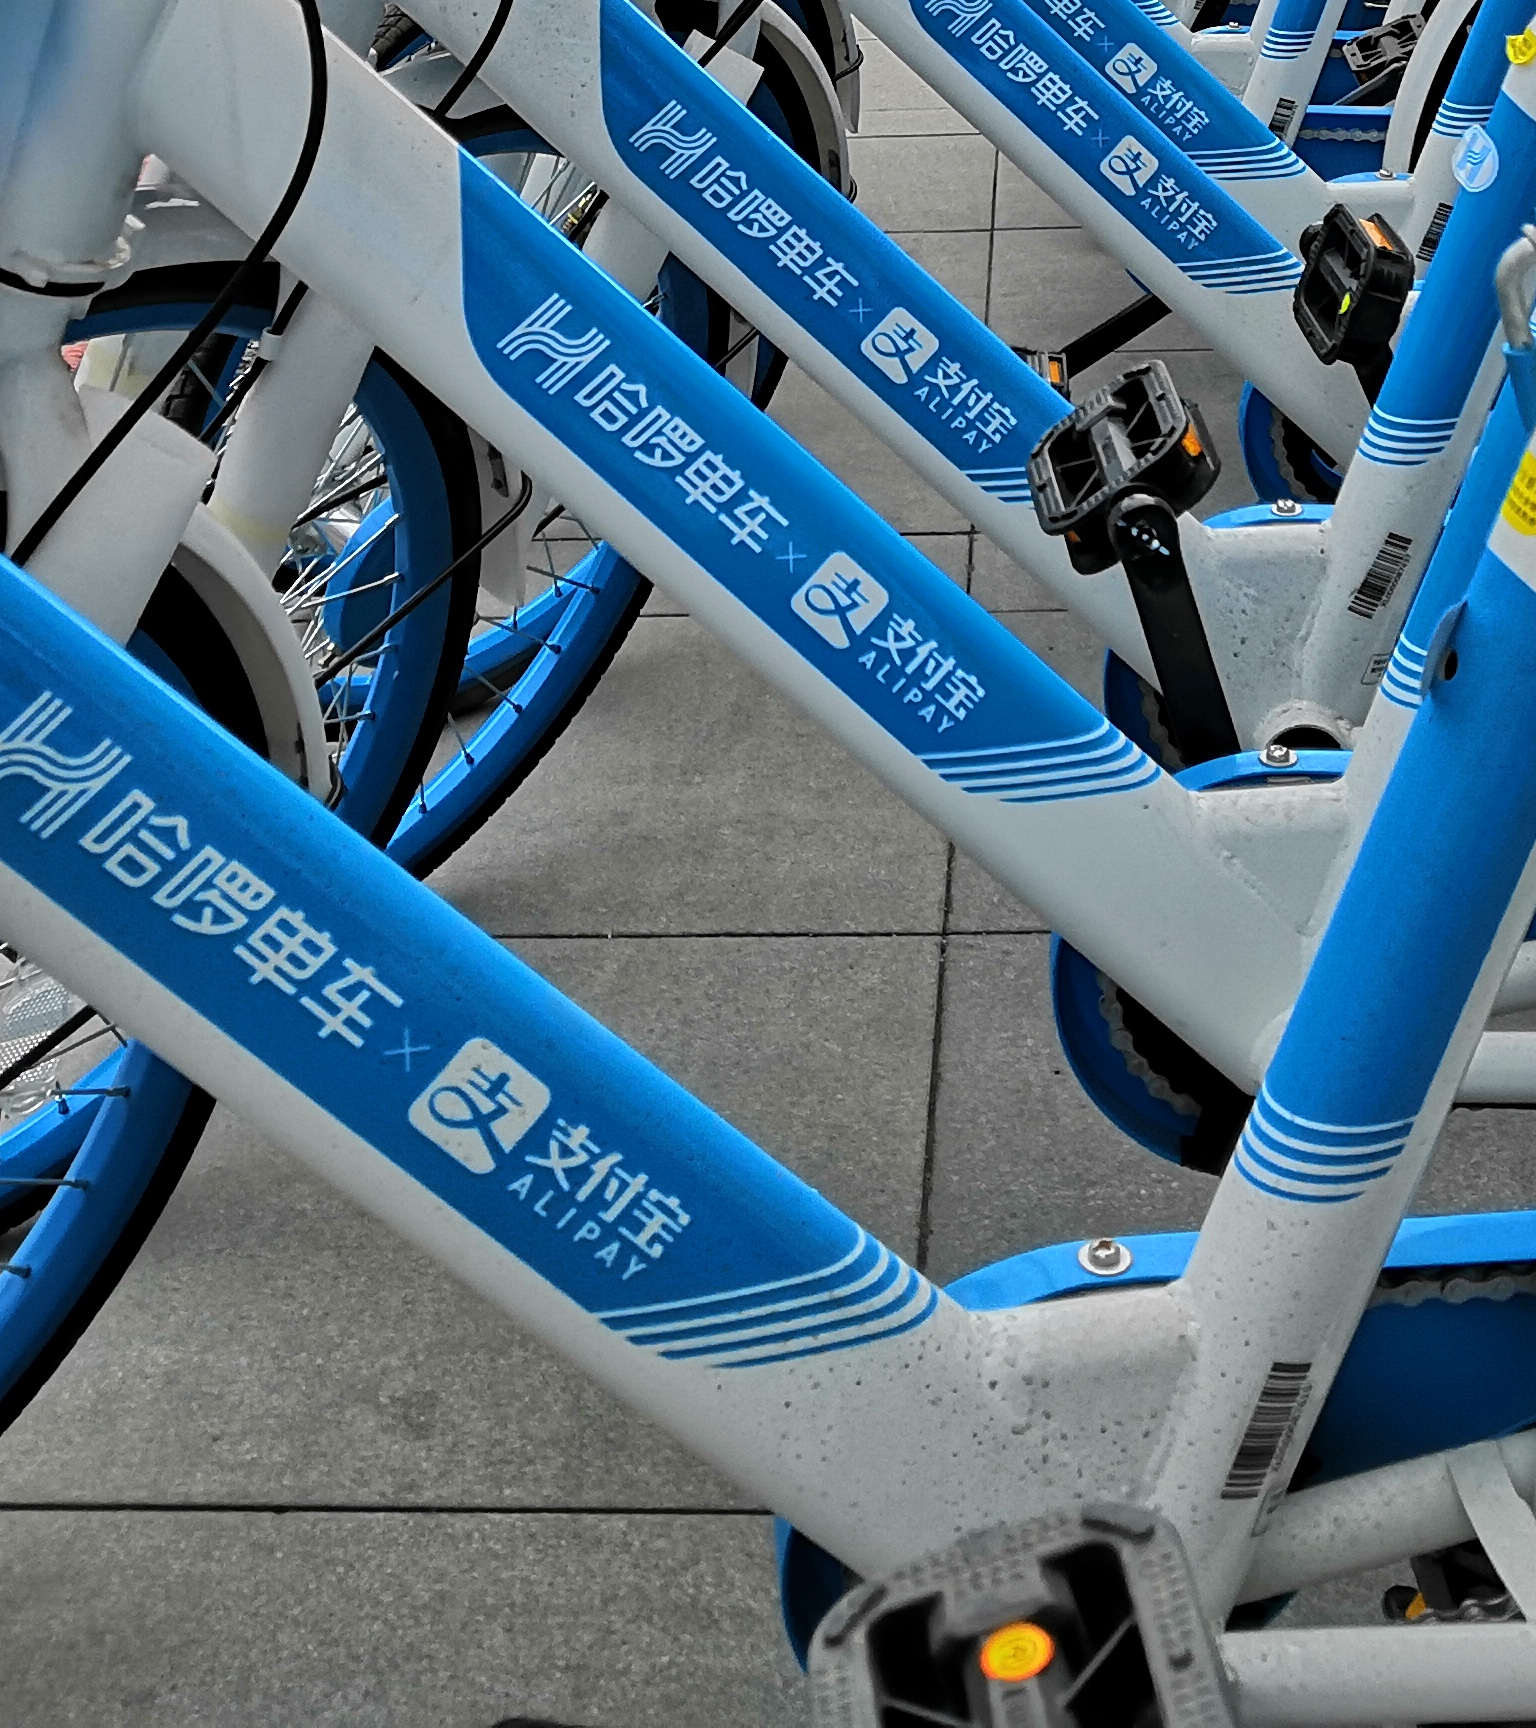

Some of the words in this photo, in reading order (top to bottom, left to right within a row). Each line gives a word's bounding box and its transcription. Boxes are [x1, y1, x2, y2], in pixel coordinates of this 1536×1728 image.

[969, 19, 1105, 140] 哈啰单车
[1147, 170, 1221, 244] 支付宝
[1139, 95, 1196, 144] ALIPAY
[1147, 75, 1212, 137] 支付宝
[1138, 194, 1202, 253] ALIPAY
[690, 154, 861, 309] 哈啰单车
[922, 353, 1020, 445] 支付宝
[912, 385, 996, 458] ALIPAY
[574, 362, 790, 556] 哈啰单车
[868, 616, 988, 724] 支付宝
[857, 650, 961, 736] ALIPAY
[80, 787, 405, 1050] 哈啰单车
[523, 1115, 691, 1260] 支付宝
[507, 1172, 651, 1283] ALIPAY
